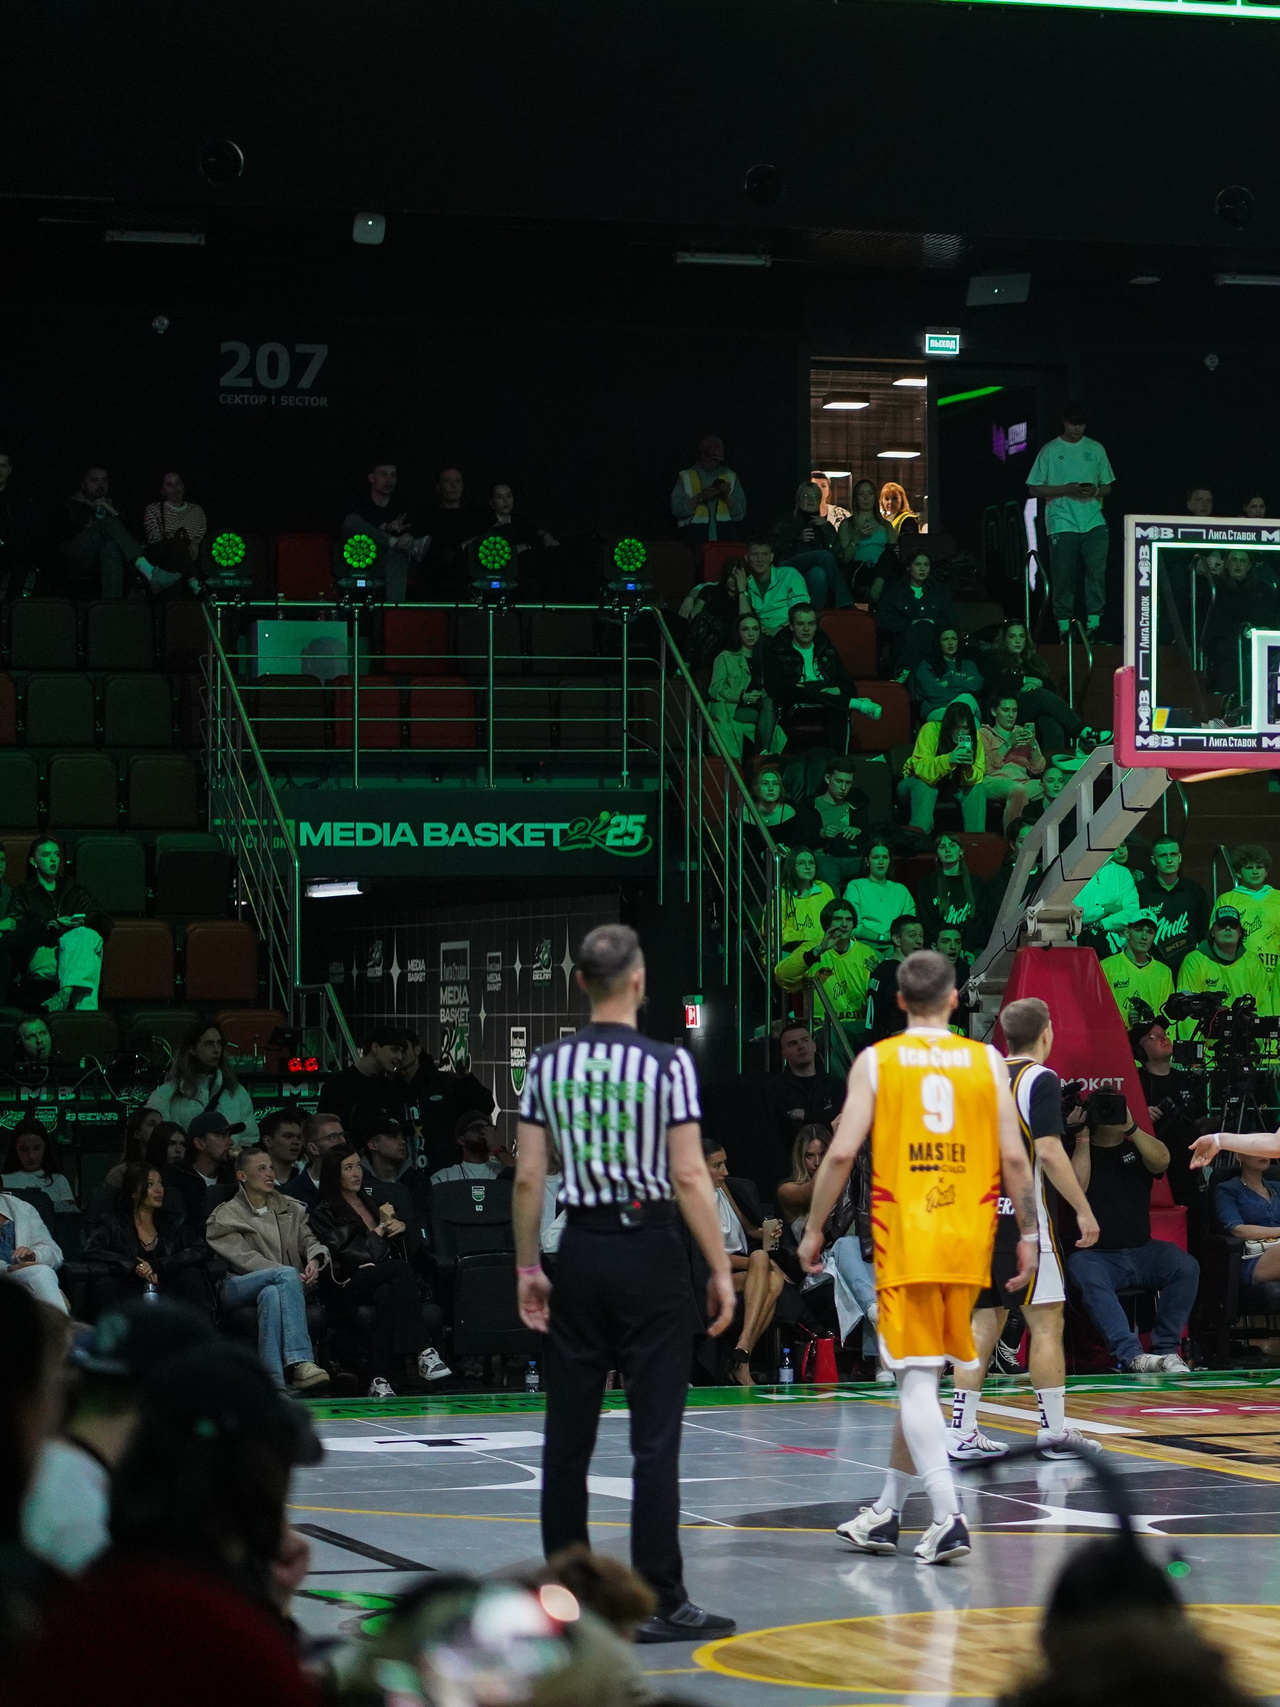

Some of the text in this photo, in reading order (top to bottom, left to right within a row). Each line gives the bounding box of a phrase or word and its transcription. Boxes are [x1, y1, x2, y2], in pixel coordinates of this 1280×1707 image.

[929, 339, 956, 350] ВЫХОД
[219, 341, 329, 389] 207
[219, 394, 328, 407] СЕКТОР SECTOR
[300, 821, 419, 847] MEDIA
[423, 822, 570, 847] BASKET
[407, 958, 427, 971] MEDIA
[439, 985, 470, 1005] MEDIA
[439, 1007, 471, 1023] BASKET
[921, 1073, 955, 1134] 9
